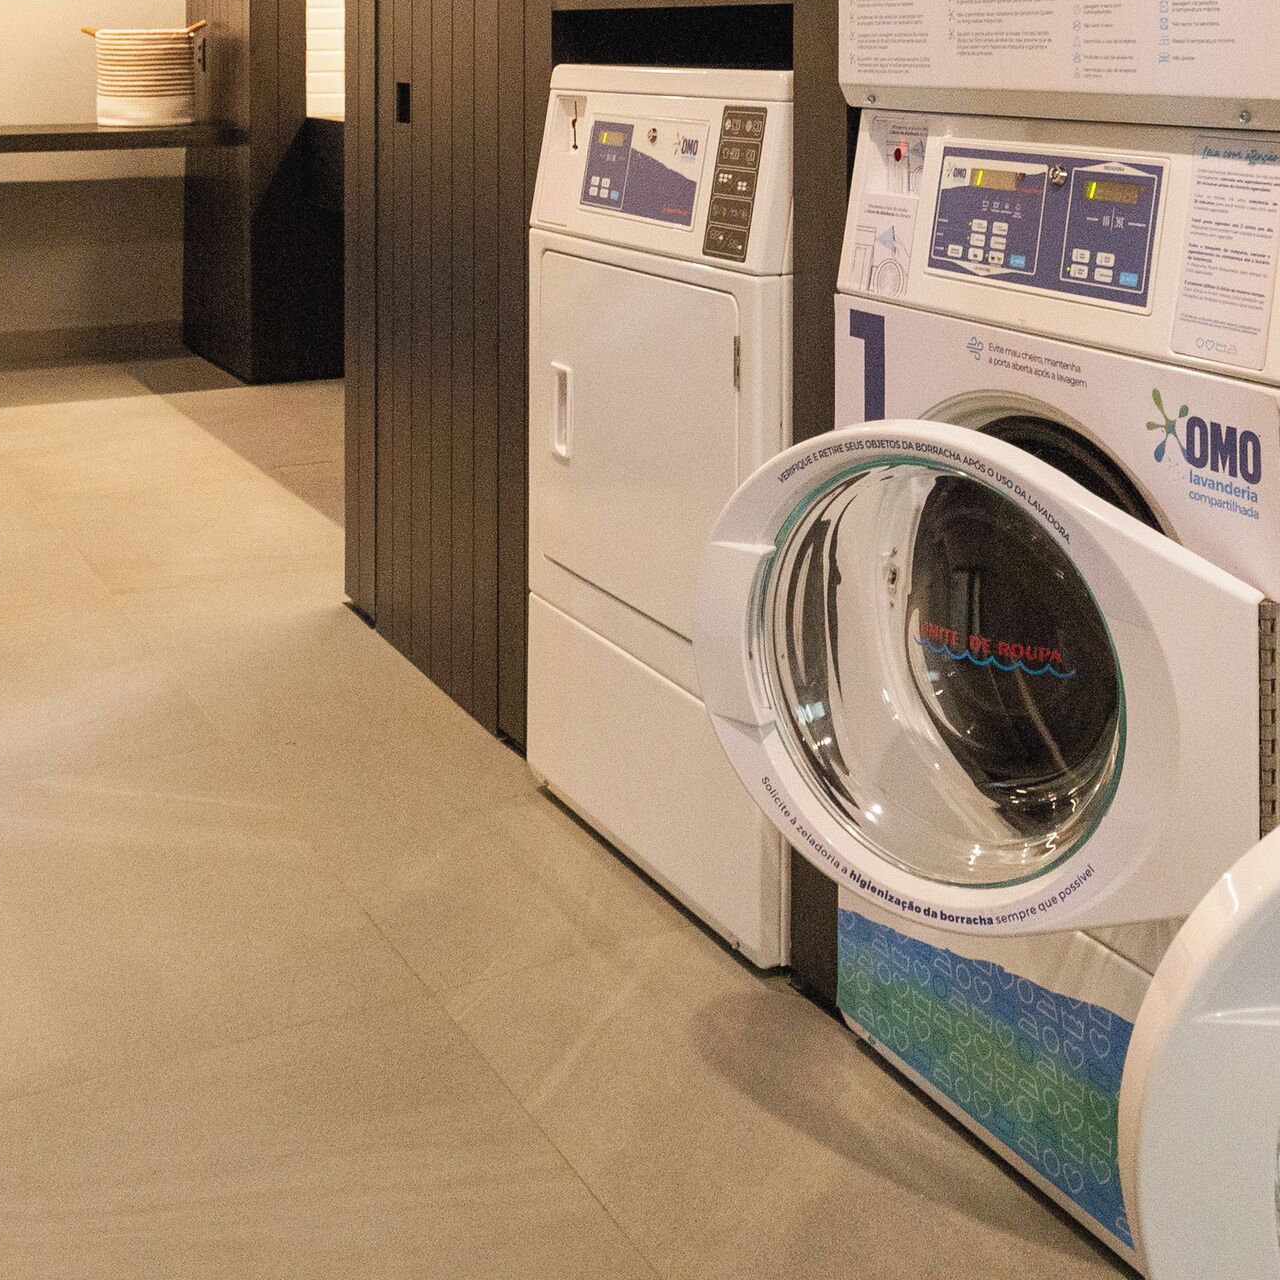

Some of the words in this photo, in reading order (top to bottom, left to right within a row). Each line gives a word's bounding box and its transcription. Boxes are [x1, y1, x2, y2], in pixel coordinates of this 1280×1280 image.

[680, 138, 699, 155] OMO
[849, 308, 886, 421] 1
[988, 342, 1005, 354] Evite
[1004, 348, 1021, 358] mau
[1020, 352, 1043, 364] cheiro,
[1044, 358, 1081, 373] mantenha
[992, 358, 1011, 368] porta
[1012, 362, 1034, 374] aberta
[1033, 369, 1051, 379] após
[1050, 372, 1056, 380] a
[1055, 371, 1087, 387] lavagem
[1185, 416, 1262, 485] OMO
[778, 455, 813, 482] VERIFIQUE
[813, 452, 819, 461] E
[819, 444, 844, 459] RETIRE
[845, 440, 864, 452] SEUS
[866, 439, 900, 449] OBJETOS
[901, 441, 915, 451] DA
[915, 442, 961, 462] BORRACHA
[963, 456, 986, 474] APÓS
[987, 468, 994, 478] O
[995, 472, 1013, 489] USO
[1014, 485, 1026, 499] DA
[1189, 469, 1259, 504] lavanderia
[1189, 489, 1260, 520] compartilhada
[969, 634, 991, 654] DE
[997, 641, 1062, 662] ROUPA
[761, 776, 791, 817] Solicite
[796, 826, 841, 869] zeladoria
[841, 865, 848, 874] a
[849, 870, 921, 913] higienização
[923, 907, 938, 919] da
[940, 911, 994, 926] borracha
[995, 906, 1037, 924] sempre
[1038, 895, 1058, 913] que
[1058, 864, 1096, 902] possível
